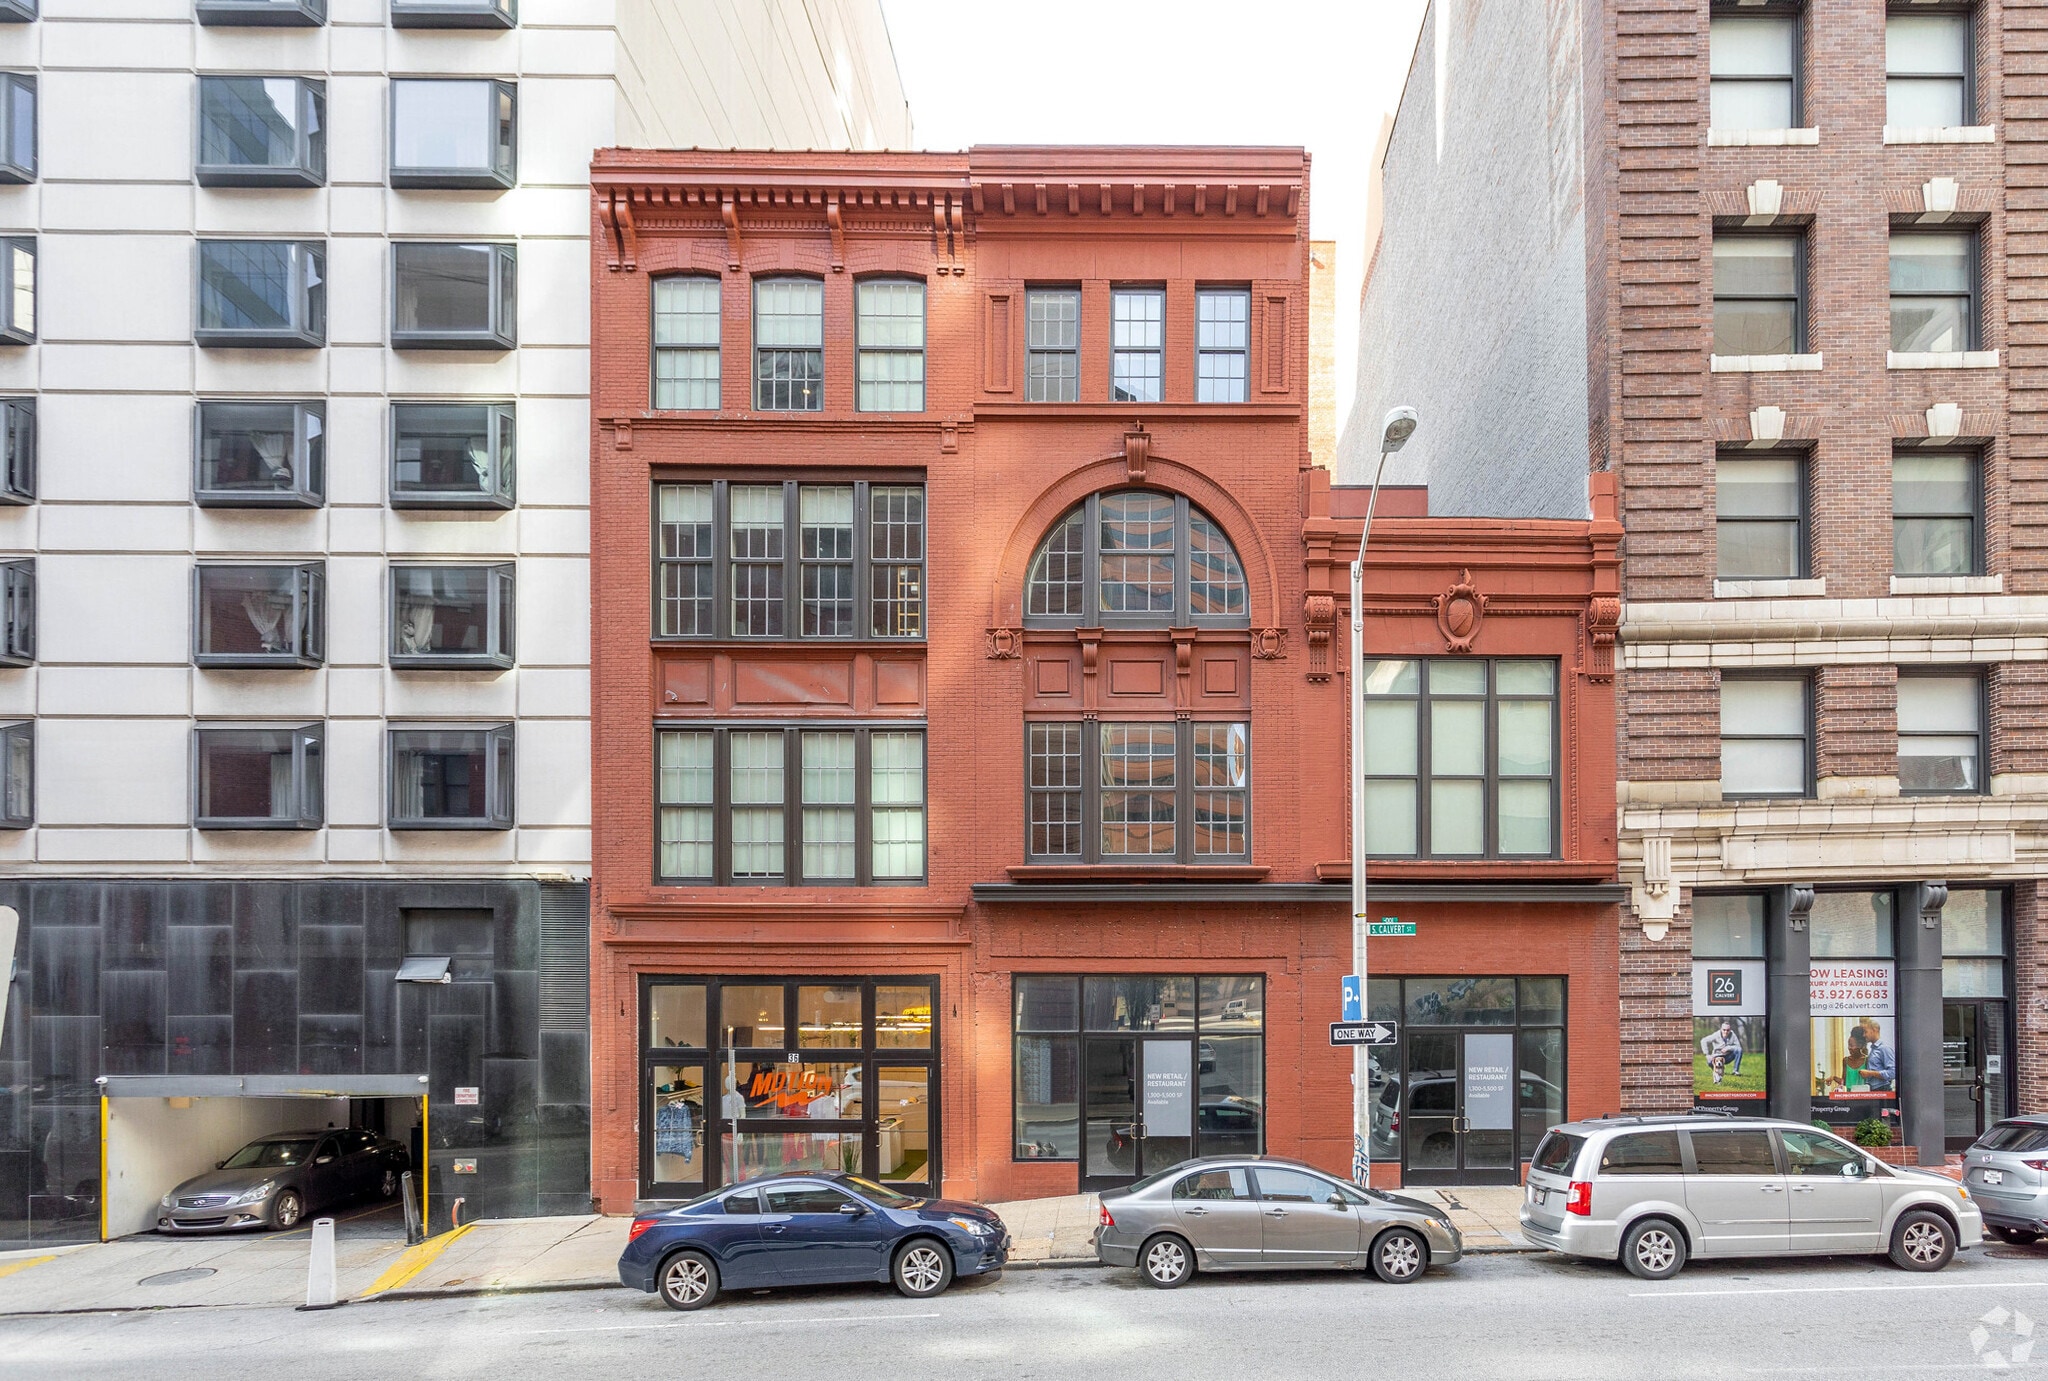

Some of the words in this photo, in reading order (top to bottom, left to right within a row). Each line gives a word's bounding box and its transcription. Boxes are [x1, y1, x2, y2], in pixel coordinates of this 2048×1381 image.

[1379, 925, 1404, 934] CALVERT
[1810, 969, 1830, 978] OW
[1834, 969, 1888, 978] LEASING!
[1715, 978, 1734, 992] 26
[1344, 986, 1353, 1011] P
[1810, 990, 1888, 999] 43.927.6683
[1810, 1002, 1888, 1010] sing@26calvert.com
[1337, 1030, 1355, 1038] ONE
[1358, 1029, 1375, 1038] WAY
[750, 1072, 832, 1097] MOTION
